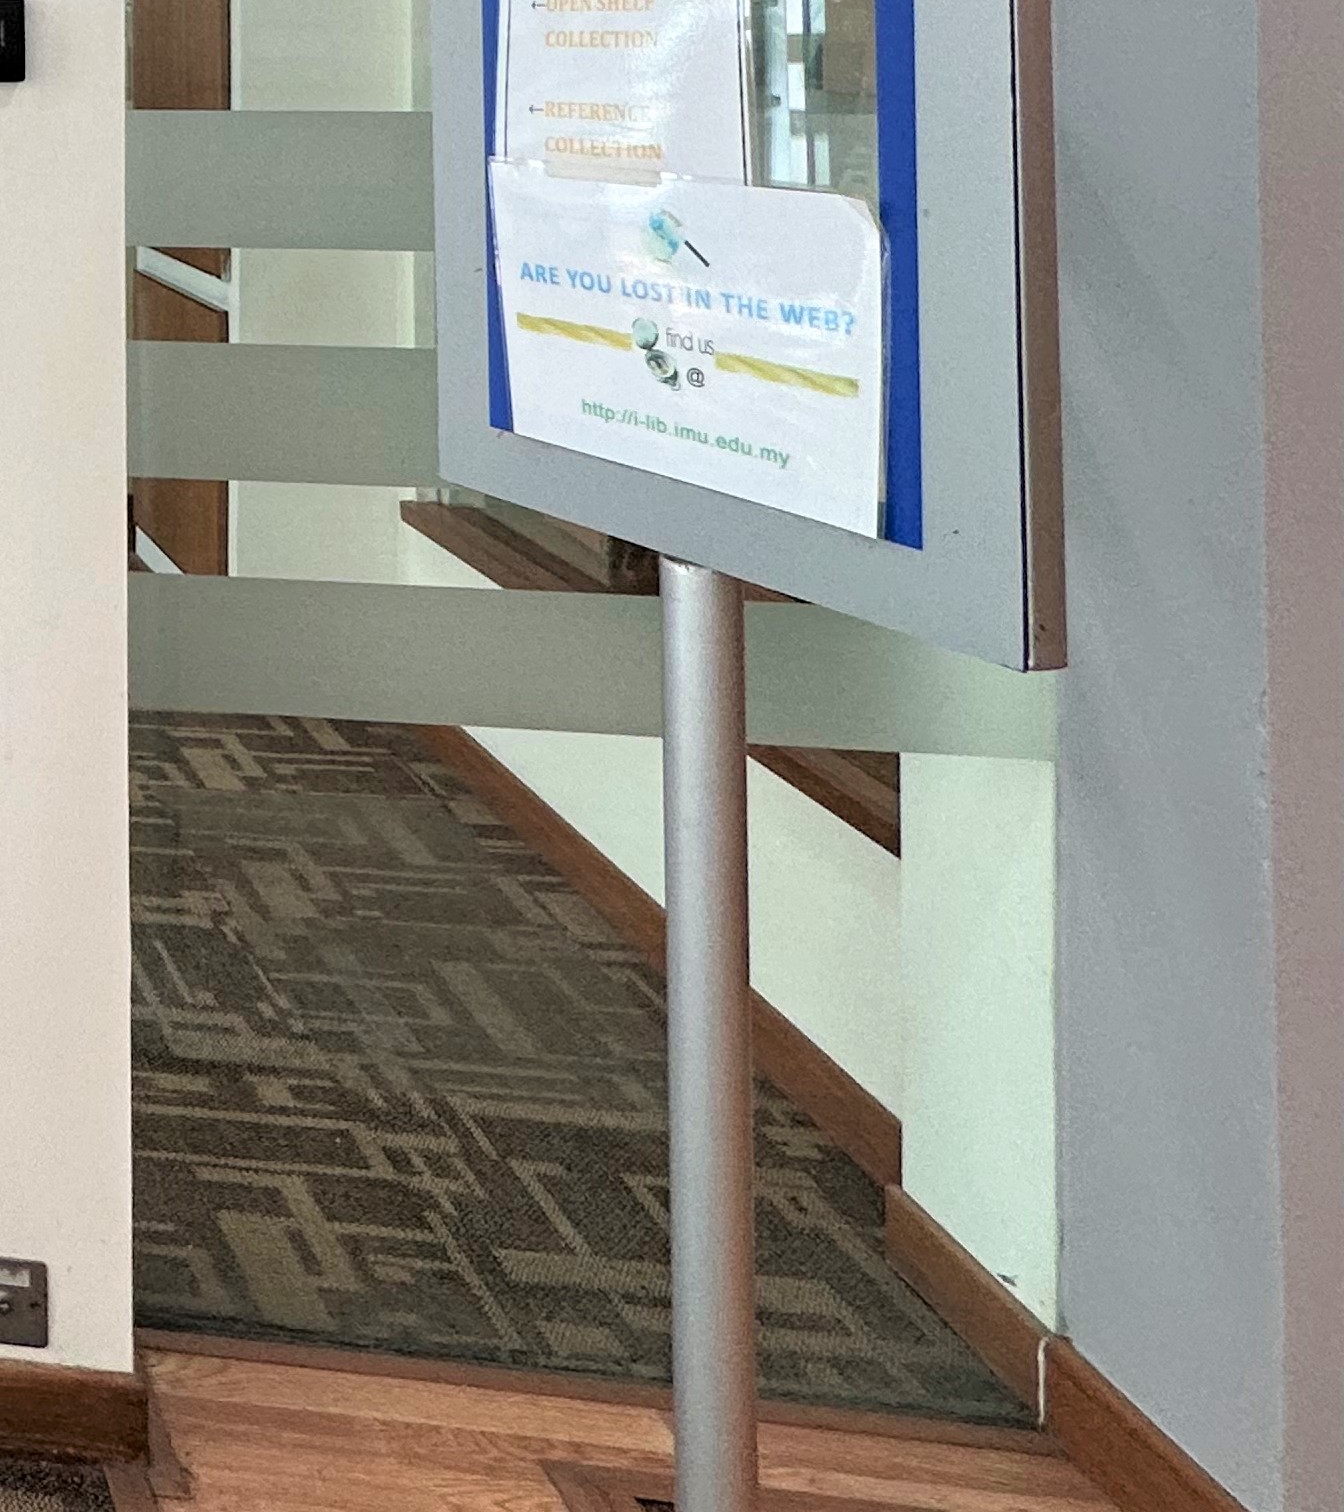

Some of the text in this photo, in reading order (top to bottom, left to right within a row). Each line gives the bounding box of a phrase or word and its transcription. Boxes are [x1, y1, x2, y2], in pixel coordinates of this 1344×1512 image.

[545, 30, 658, 48] COLLECTION
[544, 100, 651, 122] REFERENCE
[544, 136, 663, 160] COLLECTION
[520, 261, 856, 336] ARE YOU LOST IN THE WEB?
[665, 327, 715, 356] find us
[686, 367, 706, 388] @
[581, 398, 791, 468] http://i-lib.imu.edu.my
